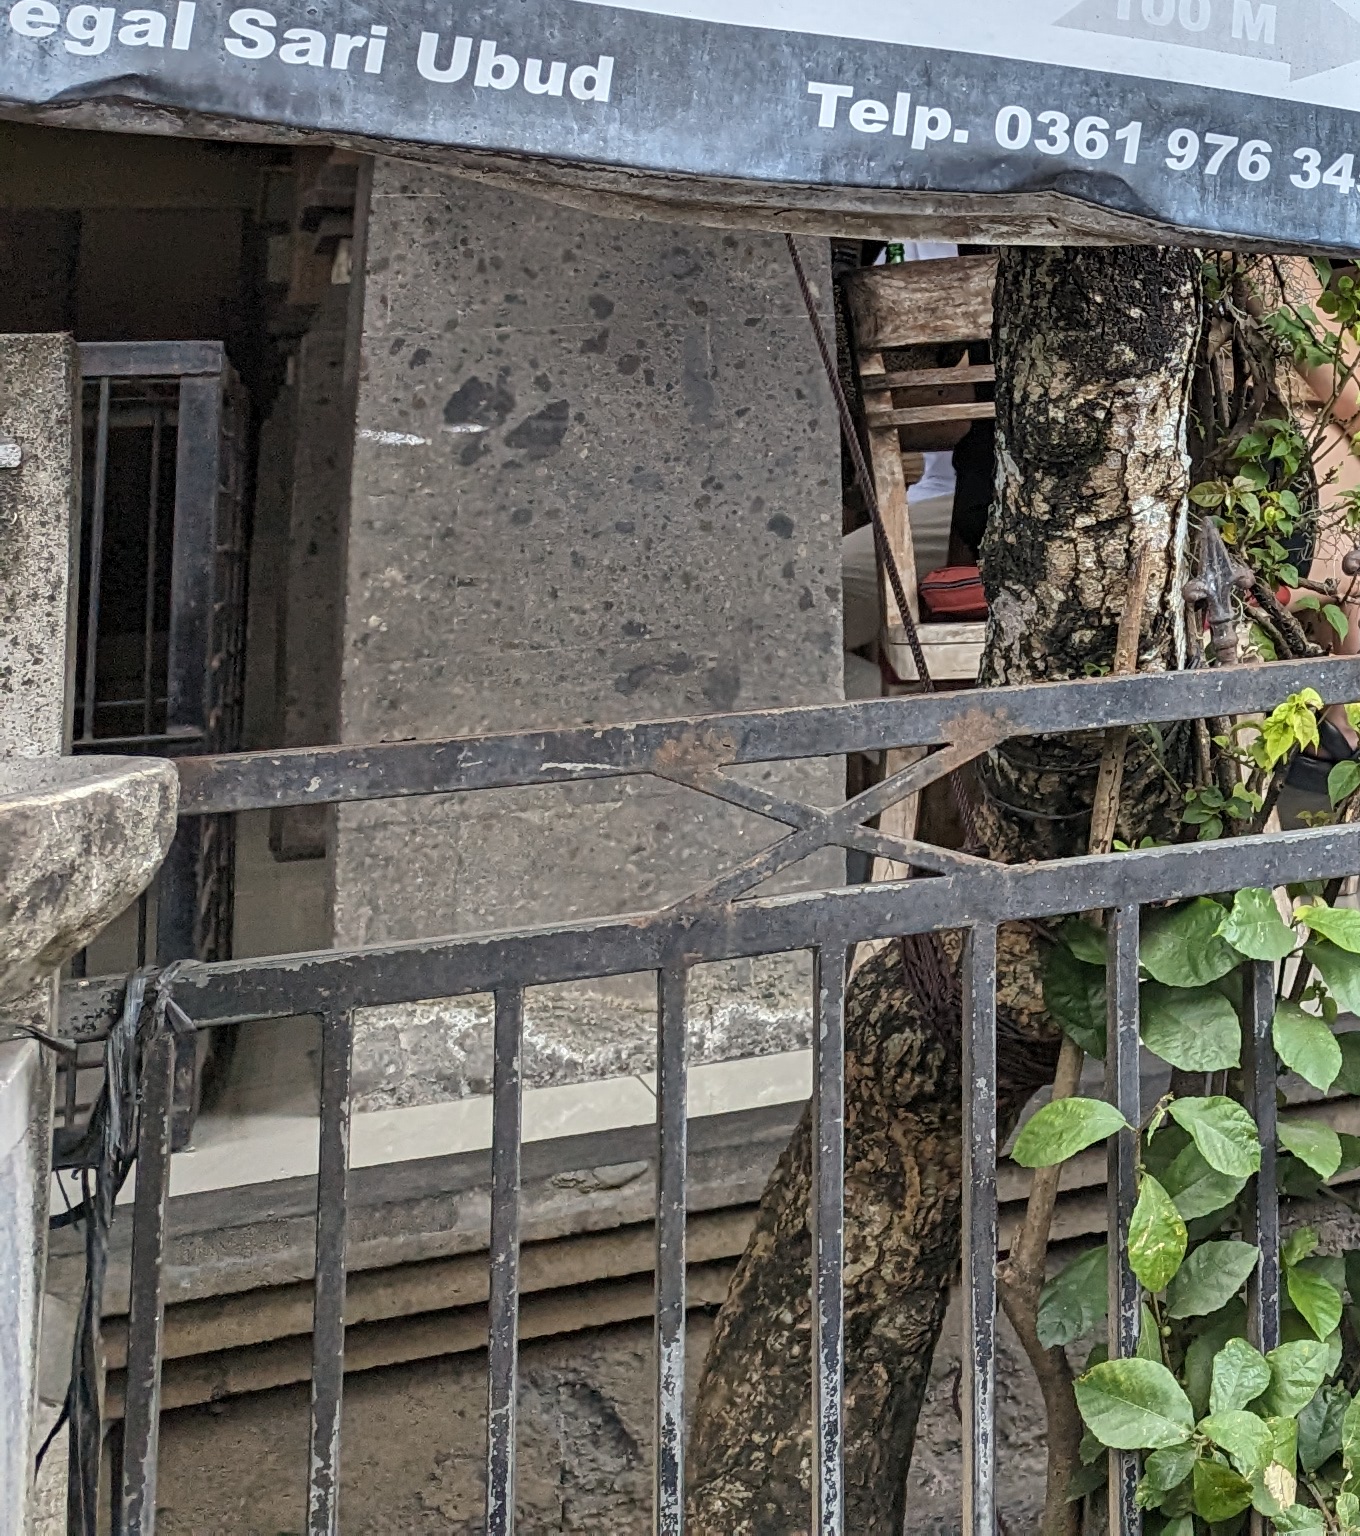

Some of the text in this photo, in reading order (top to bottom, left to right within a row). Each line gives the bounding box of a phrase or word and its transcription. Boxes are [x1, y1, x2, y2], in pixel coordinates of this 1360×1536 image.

[224, 8, 388, 74] Sari
[416, 31, 615, 103] Ubud
[1231, 0, 1277, 44] M
[807, 81, 970, 150] Telp.
[995, 105, 1143, 164] 0361
[1165, 128, 1272, 182] 976
